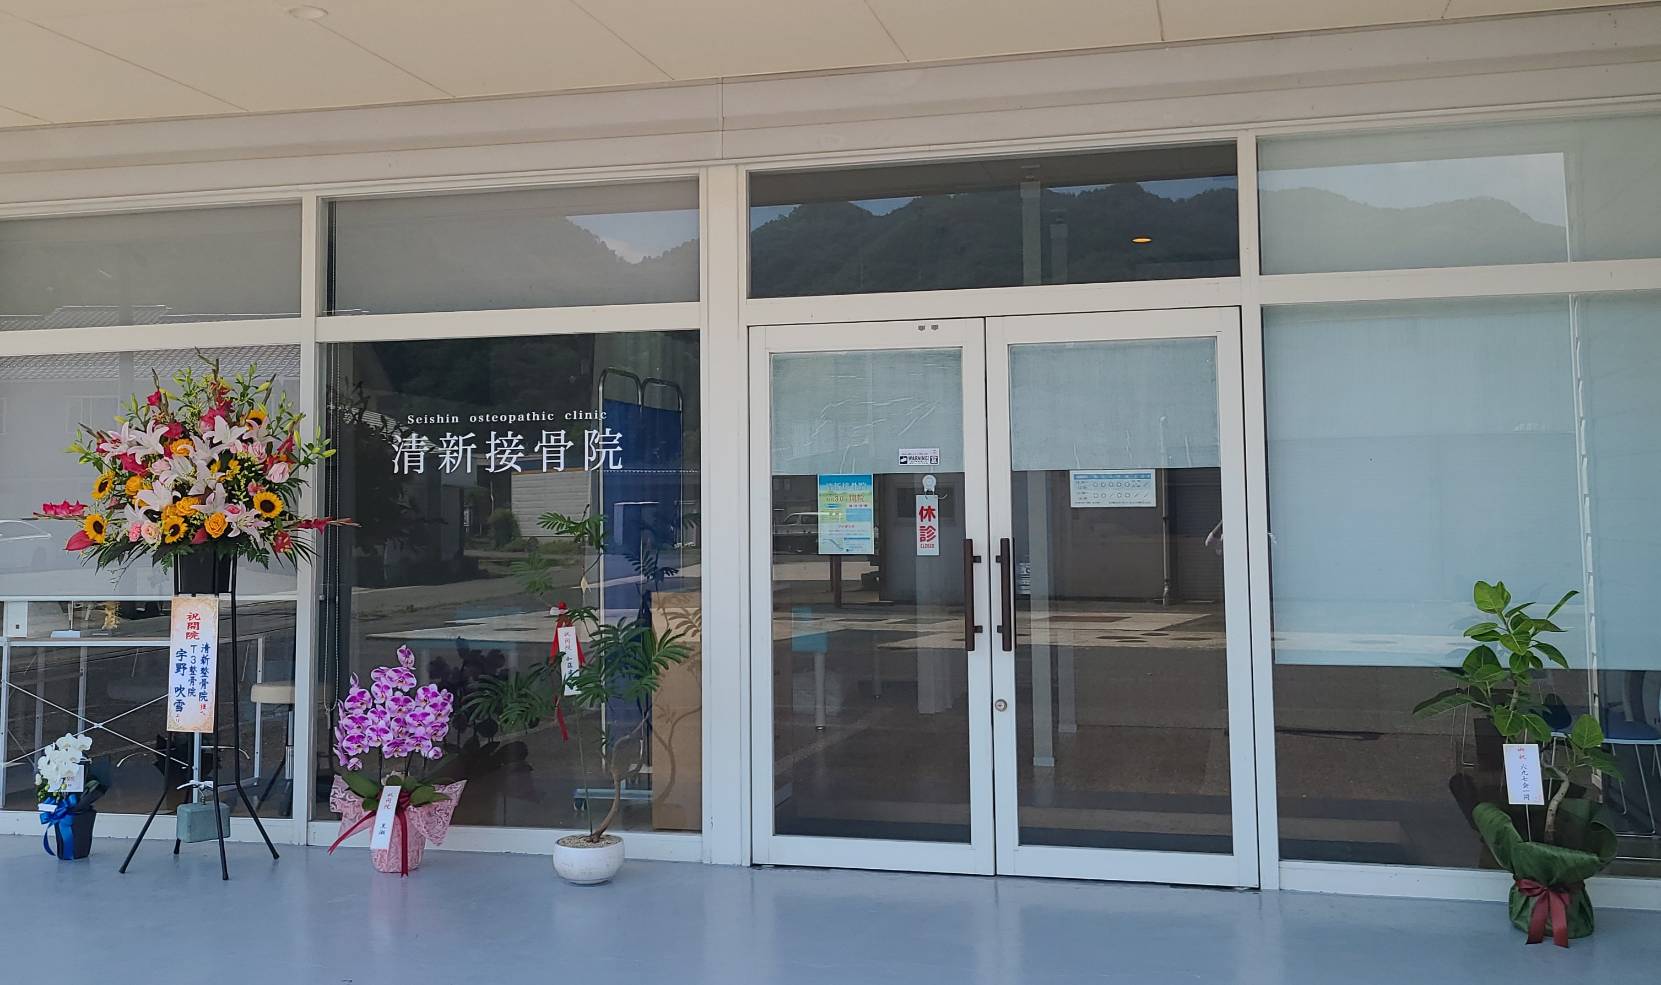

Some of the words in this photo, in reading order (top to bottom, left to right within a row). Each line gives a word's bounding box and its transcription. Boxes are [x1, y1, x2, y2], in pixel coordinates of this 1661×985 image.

[407, 414, 460, 425] Seishin
[469, 411, 555, 424] osteopathic
[564, 409, 607, 421] clinic
[391, 427, 624, 475] 清新接骨院
[918, 505, 937, 543] 休診
[185, 611, 201, 641] 祝開院
[174, 647, 188, 677] 宇野
